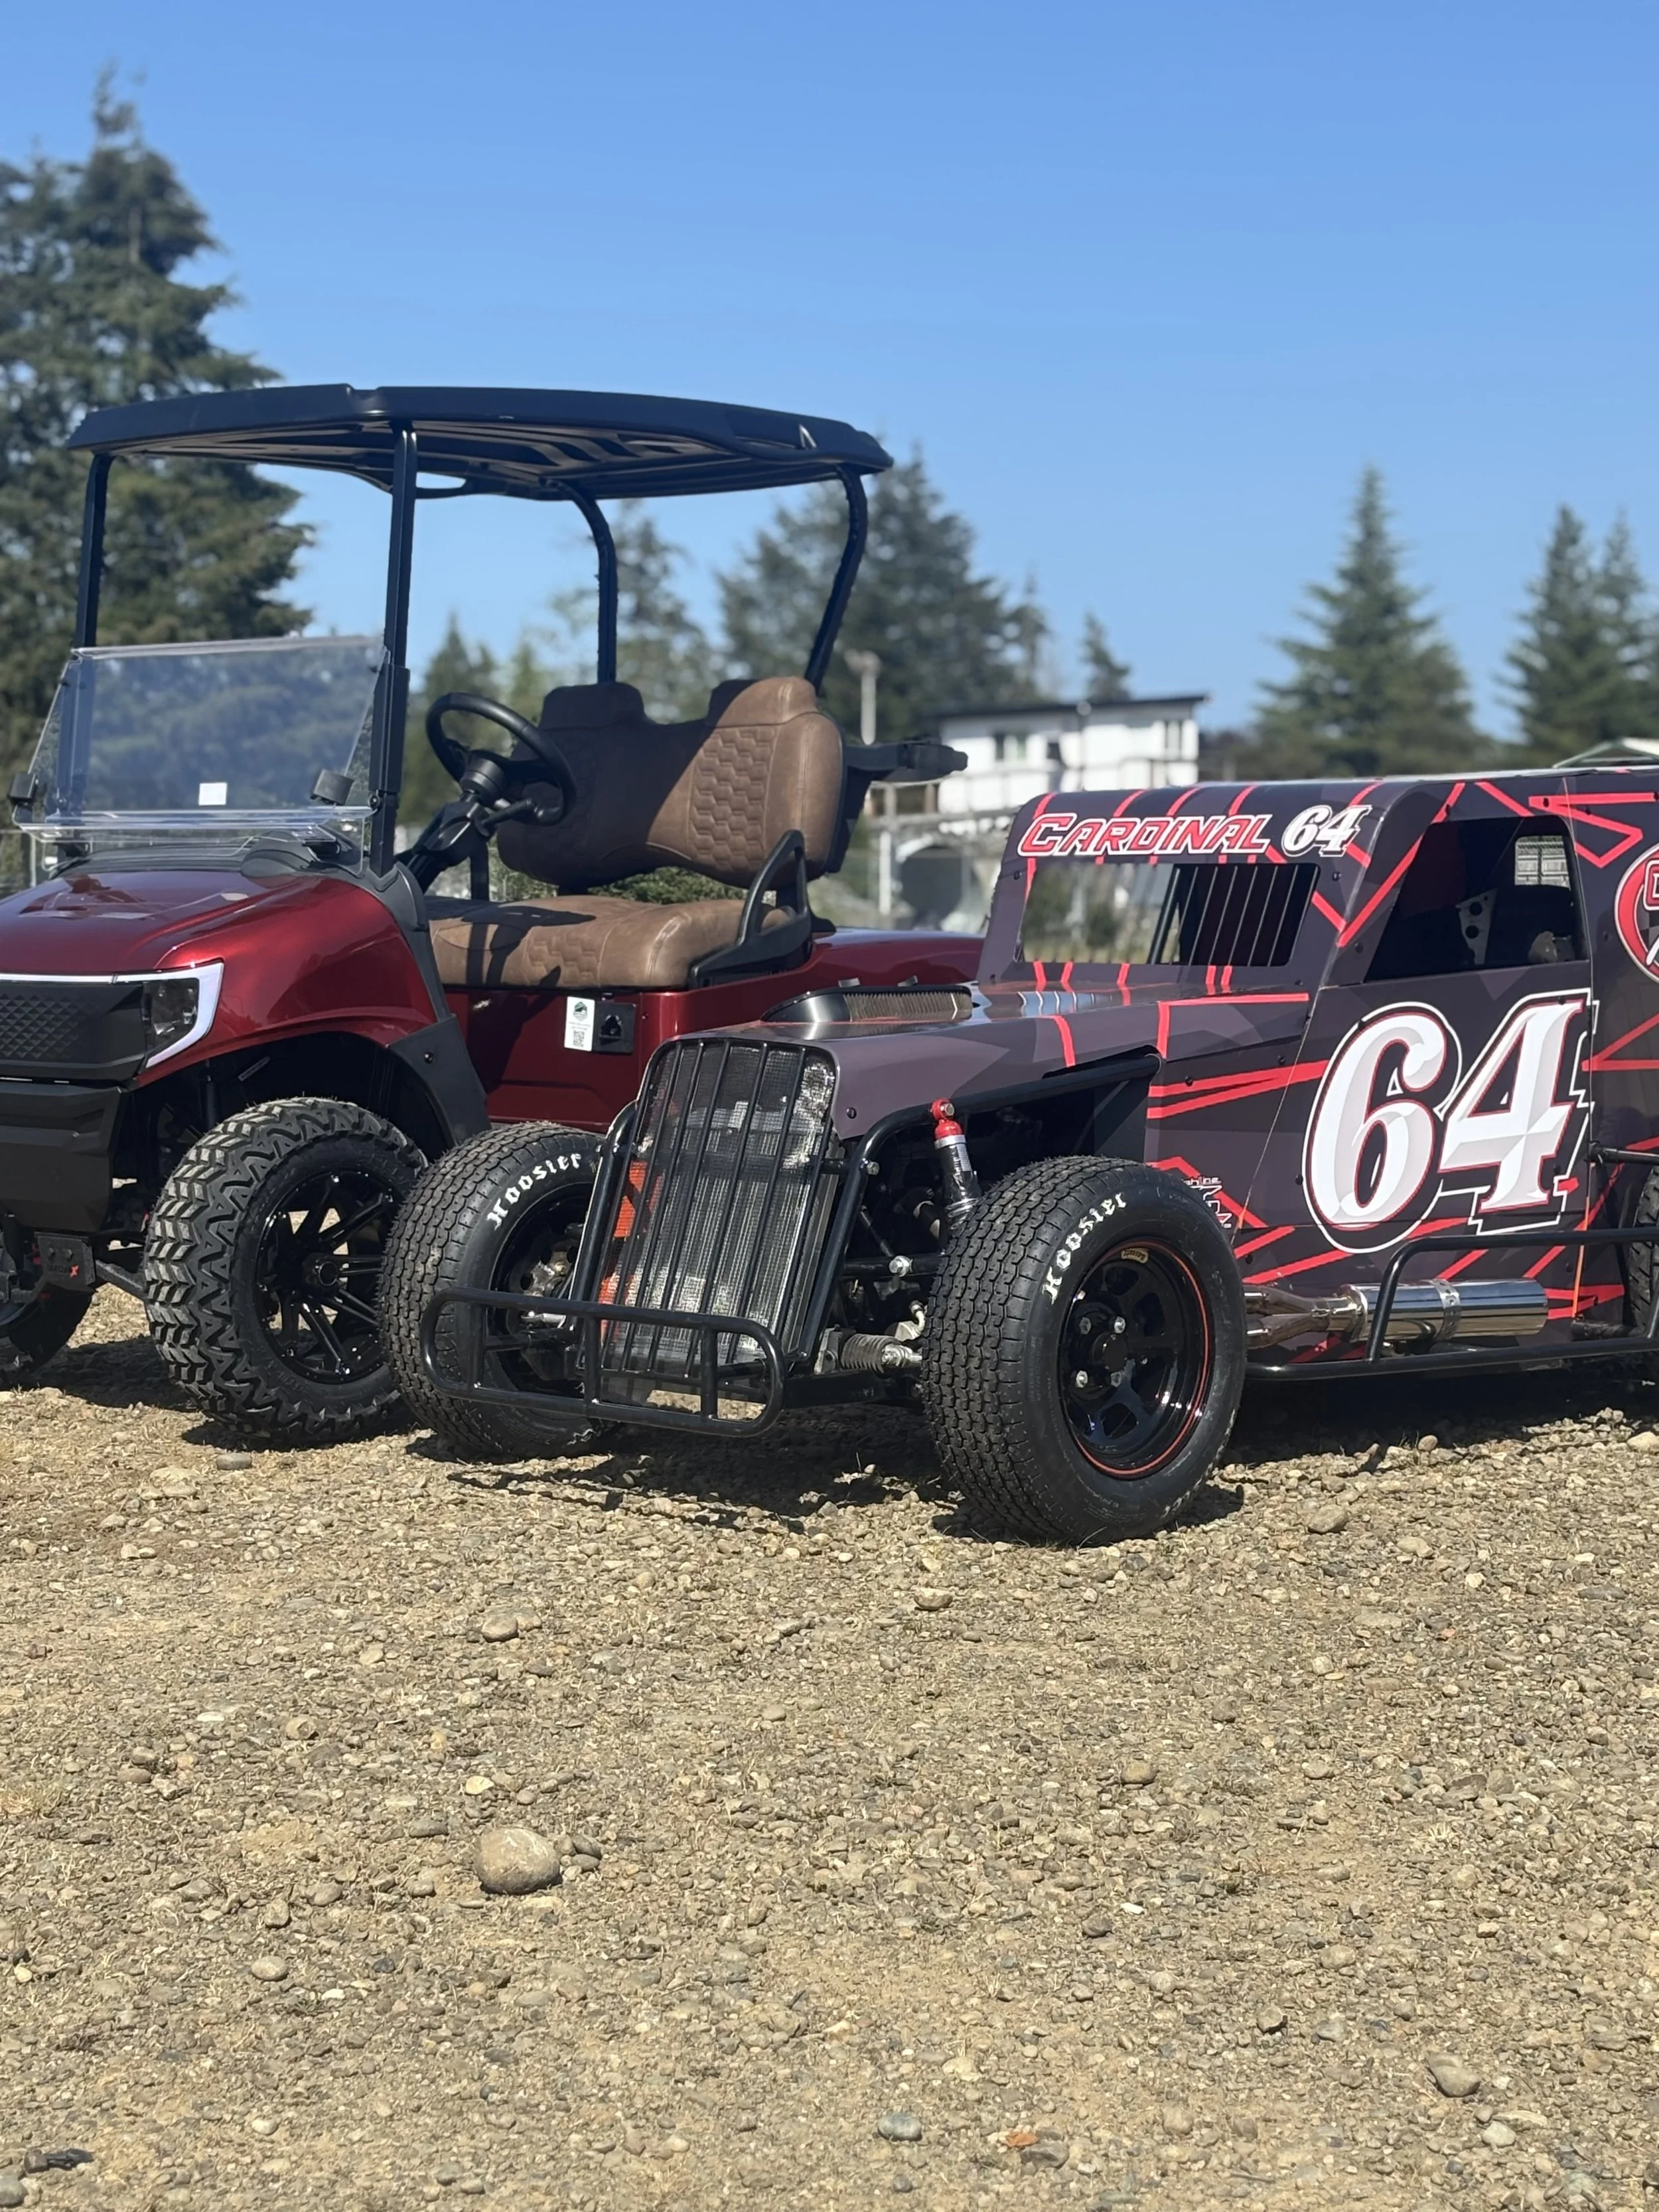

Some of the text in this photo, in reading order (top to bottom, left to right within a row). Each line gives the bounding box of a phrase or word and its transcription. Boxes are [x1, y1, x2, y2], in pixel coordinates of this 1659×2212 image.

[1017, 804, 1372, 857] CARDINAL 64
[1302, 987, 1599, 1253] 64
